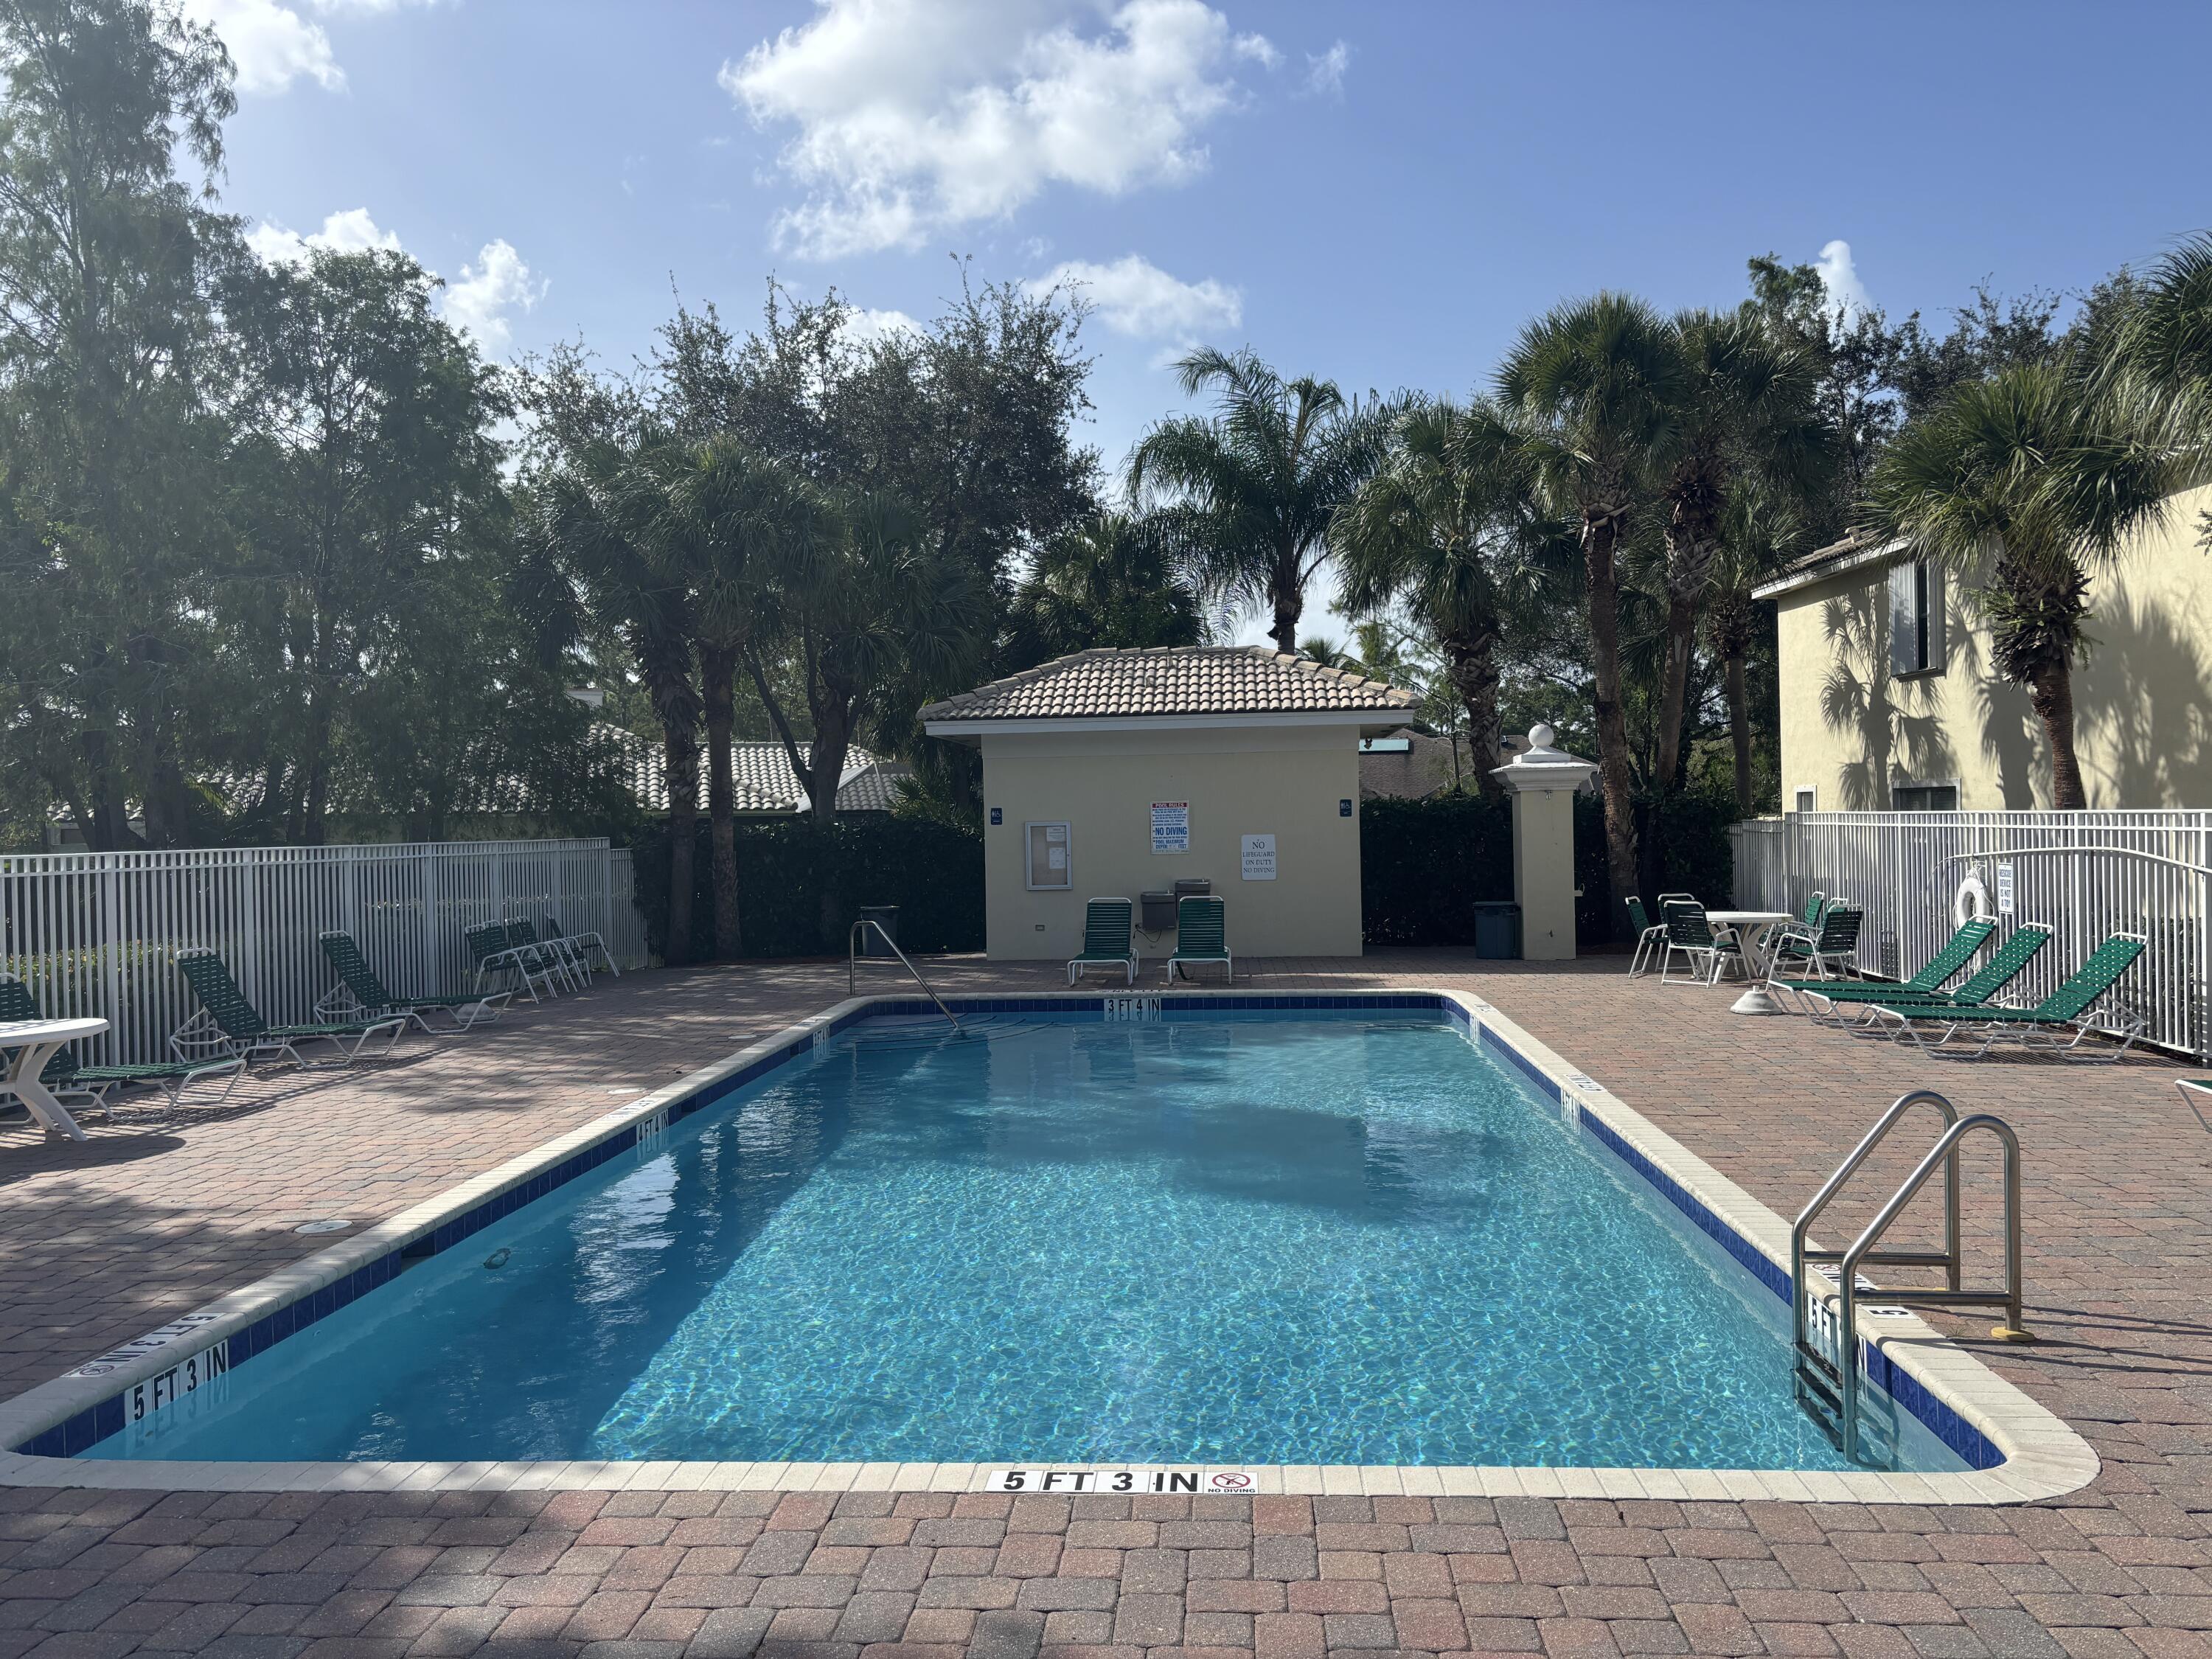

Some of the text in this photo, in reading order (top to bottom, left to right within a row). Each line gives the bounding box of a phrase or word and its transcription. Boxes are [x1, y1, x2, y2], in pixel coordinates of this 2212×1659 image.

[1155, 827, 1187, 835] NO DIVING
[1252, 841, 1265, 849] NO
[1999, 869, 2011, 877] RESCUE
[2000, 879, 2011, 888] DEVICE
[2000, 888, 2004, 897] IS
[1108, 998, 1160, 1012] 3 FT 4 IN
[639, 1110, 668, 1141] 4 FT 4 IN
[1812, 1297, 1818, 1329] 5
[1821, 1305, 1834, 1343] FT
[152, 1324, 200, 1337] FT
[94, 1351, 148, 1362] IN
[133, 1342, 226, 1421] 5 FT 3 IN
[1004, 1471, 1197, 1492] 5 FT 3 IN
